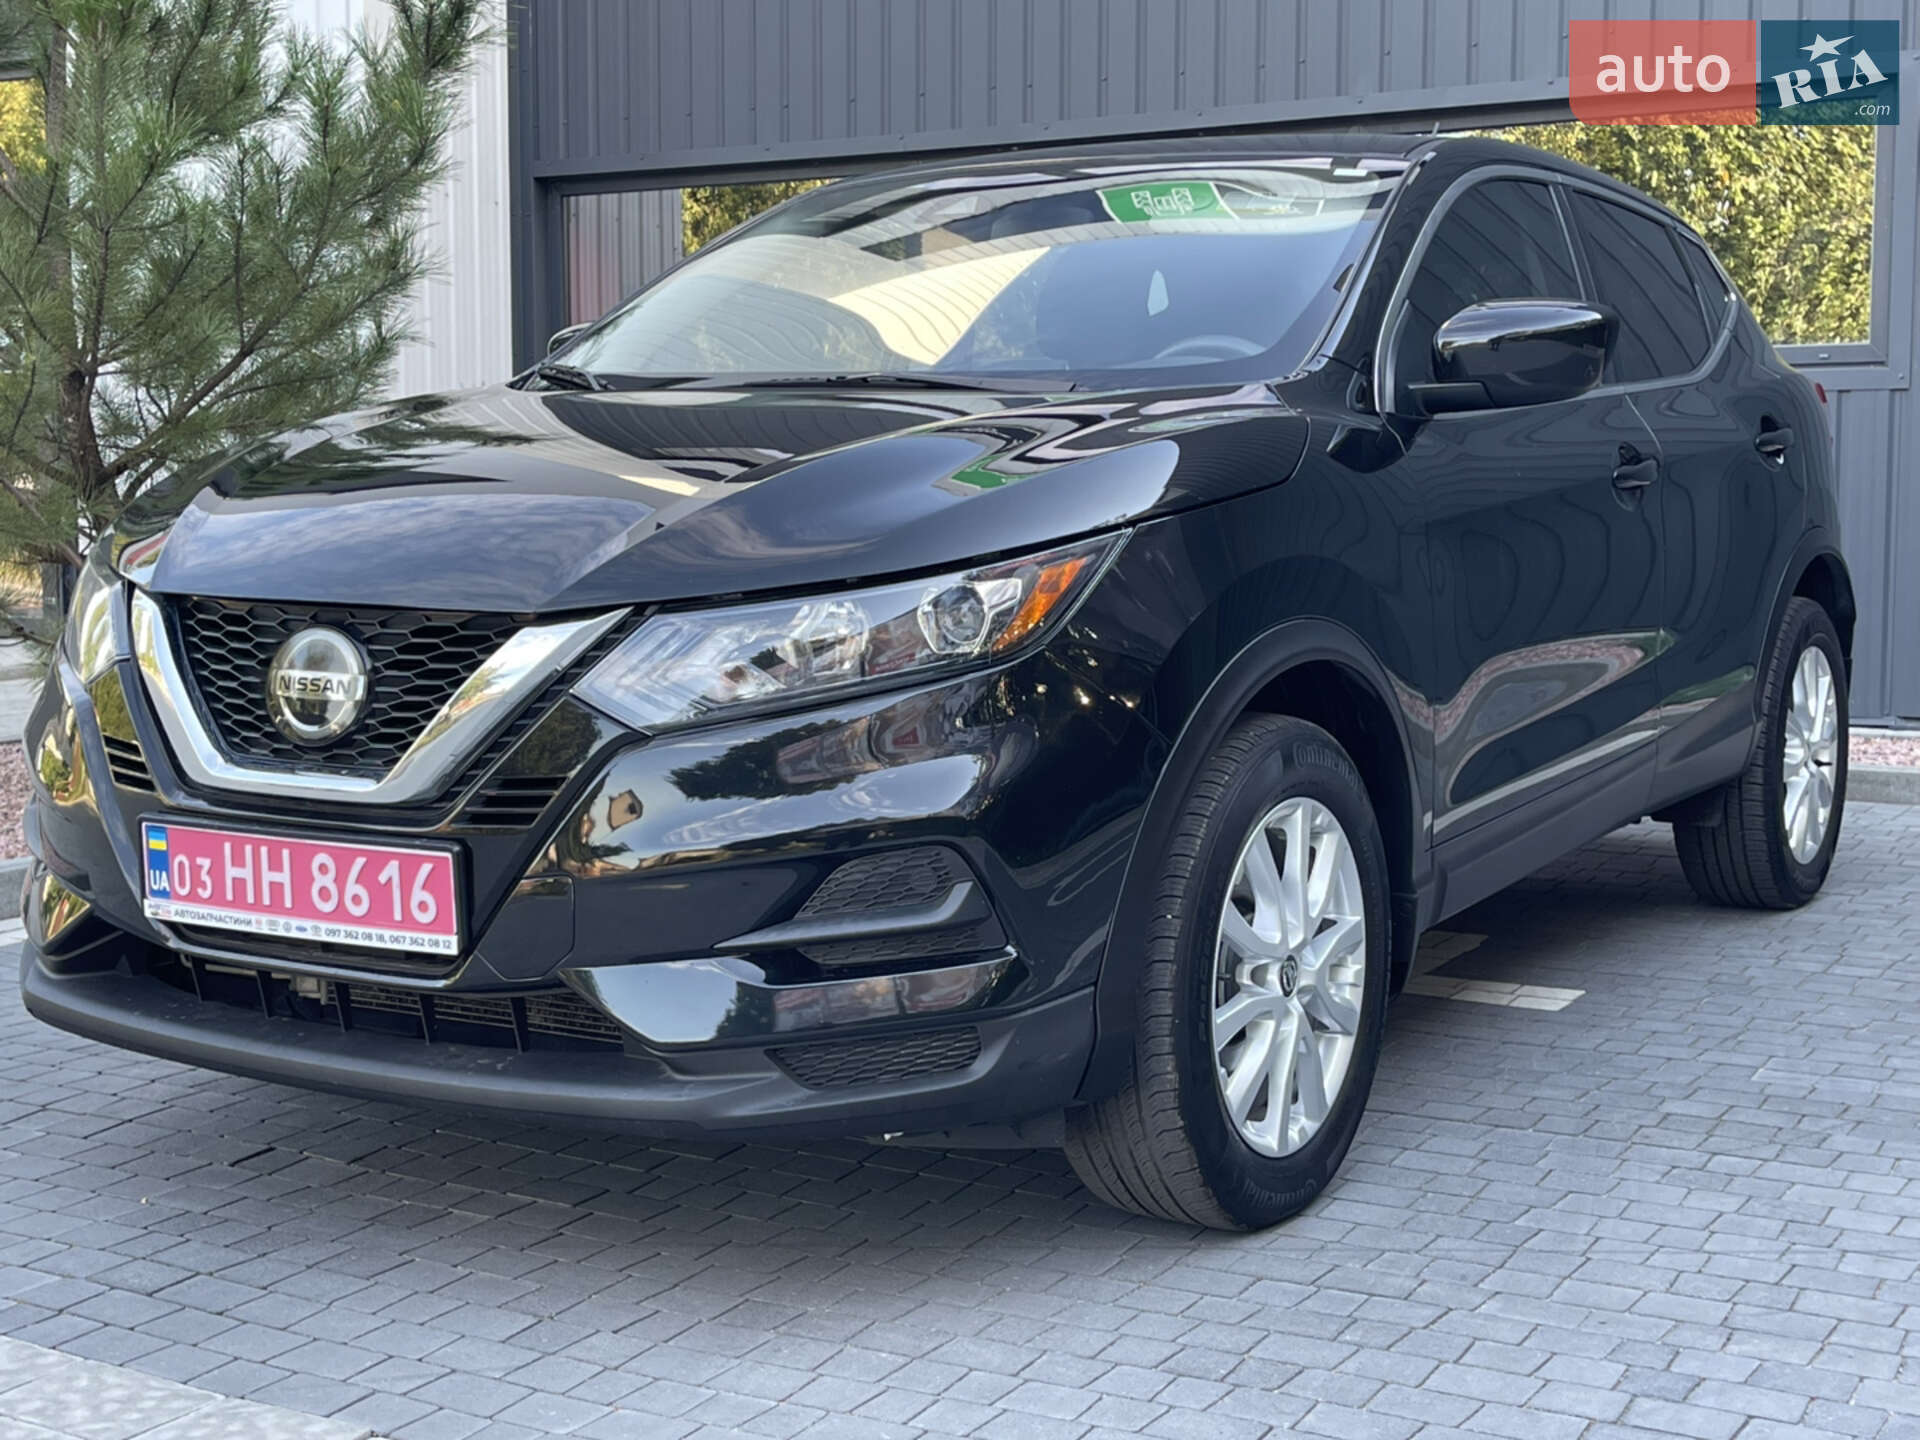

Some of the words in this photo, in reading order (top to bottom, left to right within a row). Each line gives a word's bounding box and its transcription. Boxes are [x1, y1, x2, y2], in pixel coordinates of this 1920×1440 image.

[280, 674, 352, 695] NISSAN
[150, 869, 170, 892] UA
[173, 854, 213, 899] 03
[224, 842, 293, 909] HH
[311, 852, 438, 924] 8616
[174, 909, 253, 926] АВТОЗАПЧАСТИНИ
[324, 928, 341, 937] 097
[343, 930, 359, 940] 362
[361, 932, 373, 941] 08
[389, 935, 407, 945] 067
[408, 936, 425, 947] 362
[427, 938, 441, 948] 08
[442, 940, 452, 949] 12
